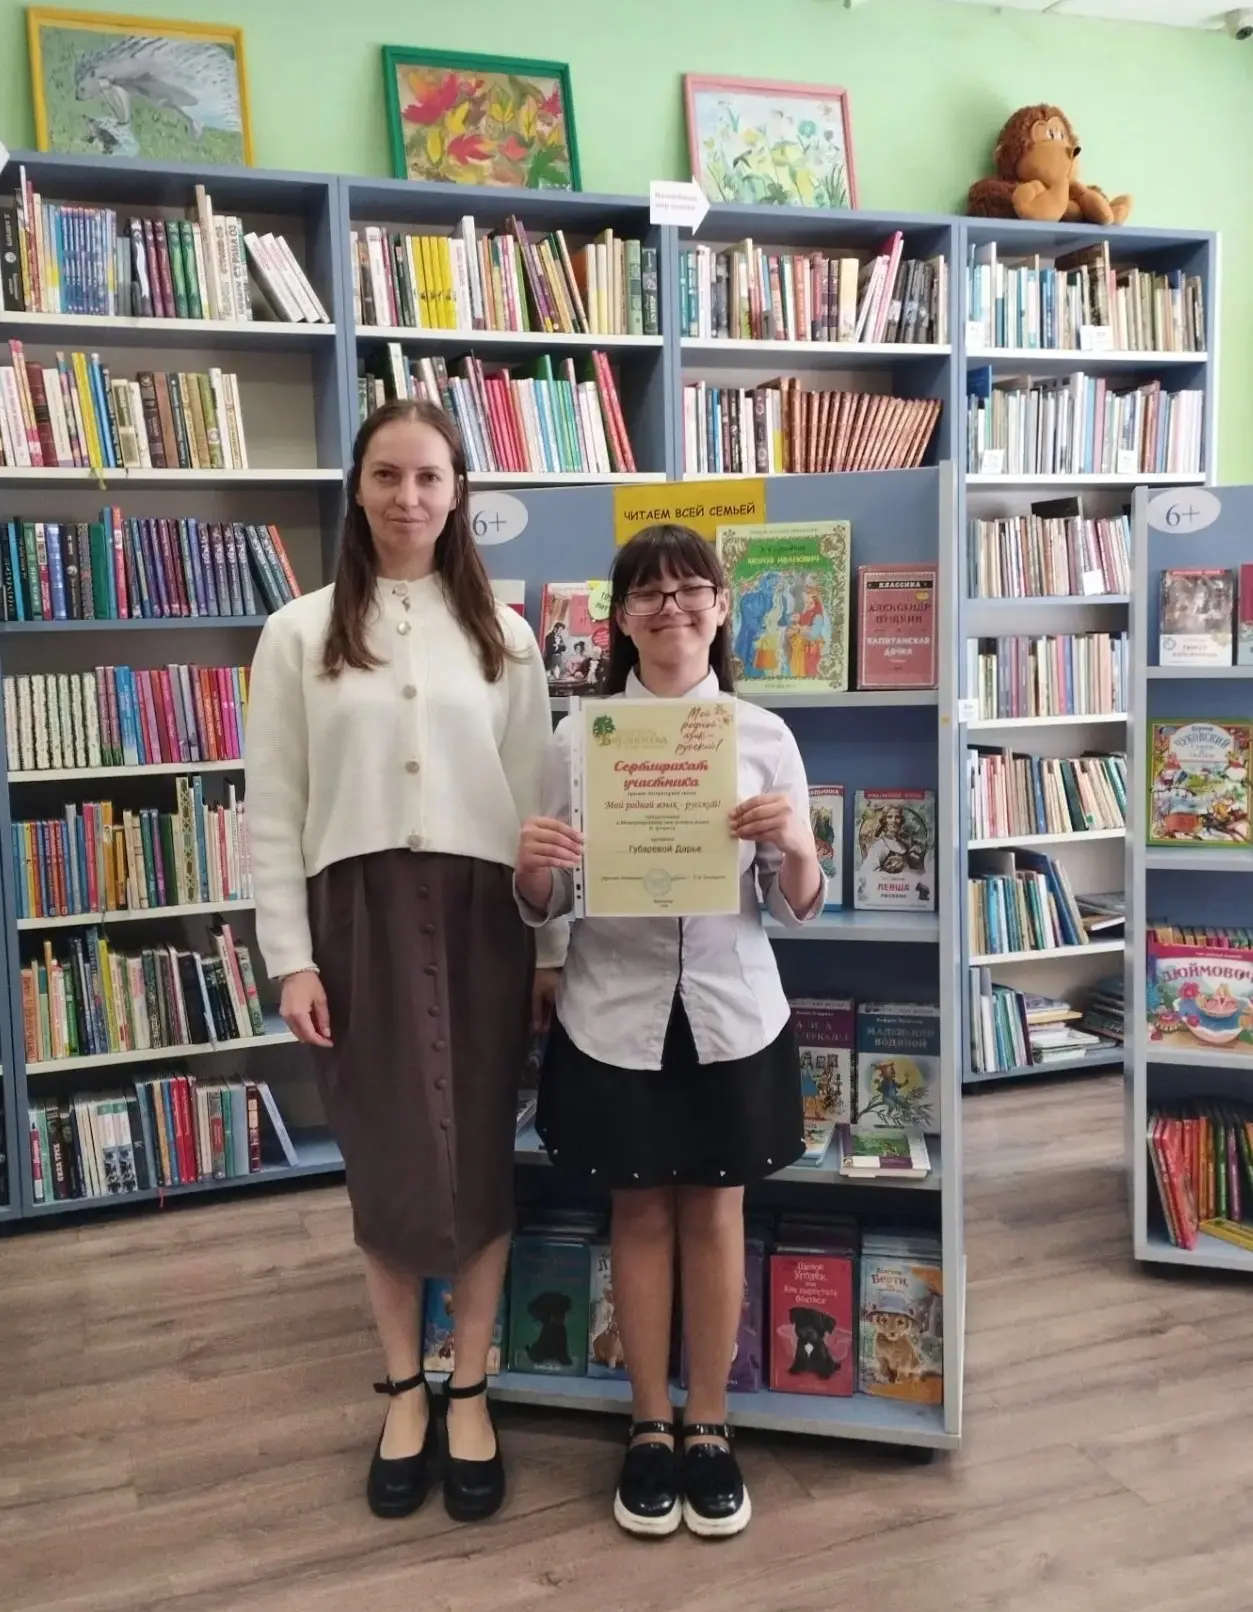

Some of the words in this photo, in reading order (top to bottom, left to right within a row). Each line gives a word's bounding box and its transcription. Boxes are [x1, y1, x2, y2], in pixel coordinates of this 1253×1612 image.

[623, 508, 671, 521] ЧИТАЕМ
[675, 504, 705, 518] ВСЕЙ
[709, 501, 756, 517] СЕМЬЕЙ
[1165, 503, 1201, 527] 6+
[472, 510, 507, 537] 6+
[878, 581, 921, 589] КЛАССИКА
[868, 603, 932, 612] АЛЕКСАНДР
[867, 637, 931, 645] КАПИТАНСКАЯ
[883, 648, 913, 657] ДОЧКА
[613, 760, 709, 775] Сертификат
[623, 776, 700, 790] участника
[629, 845, 673, 854] Губаревой
[675, 845, 702, 854] Дарье
[878, 883, 910, 892] ЛЕВША
